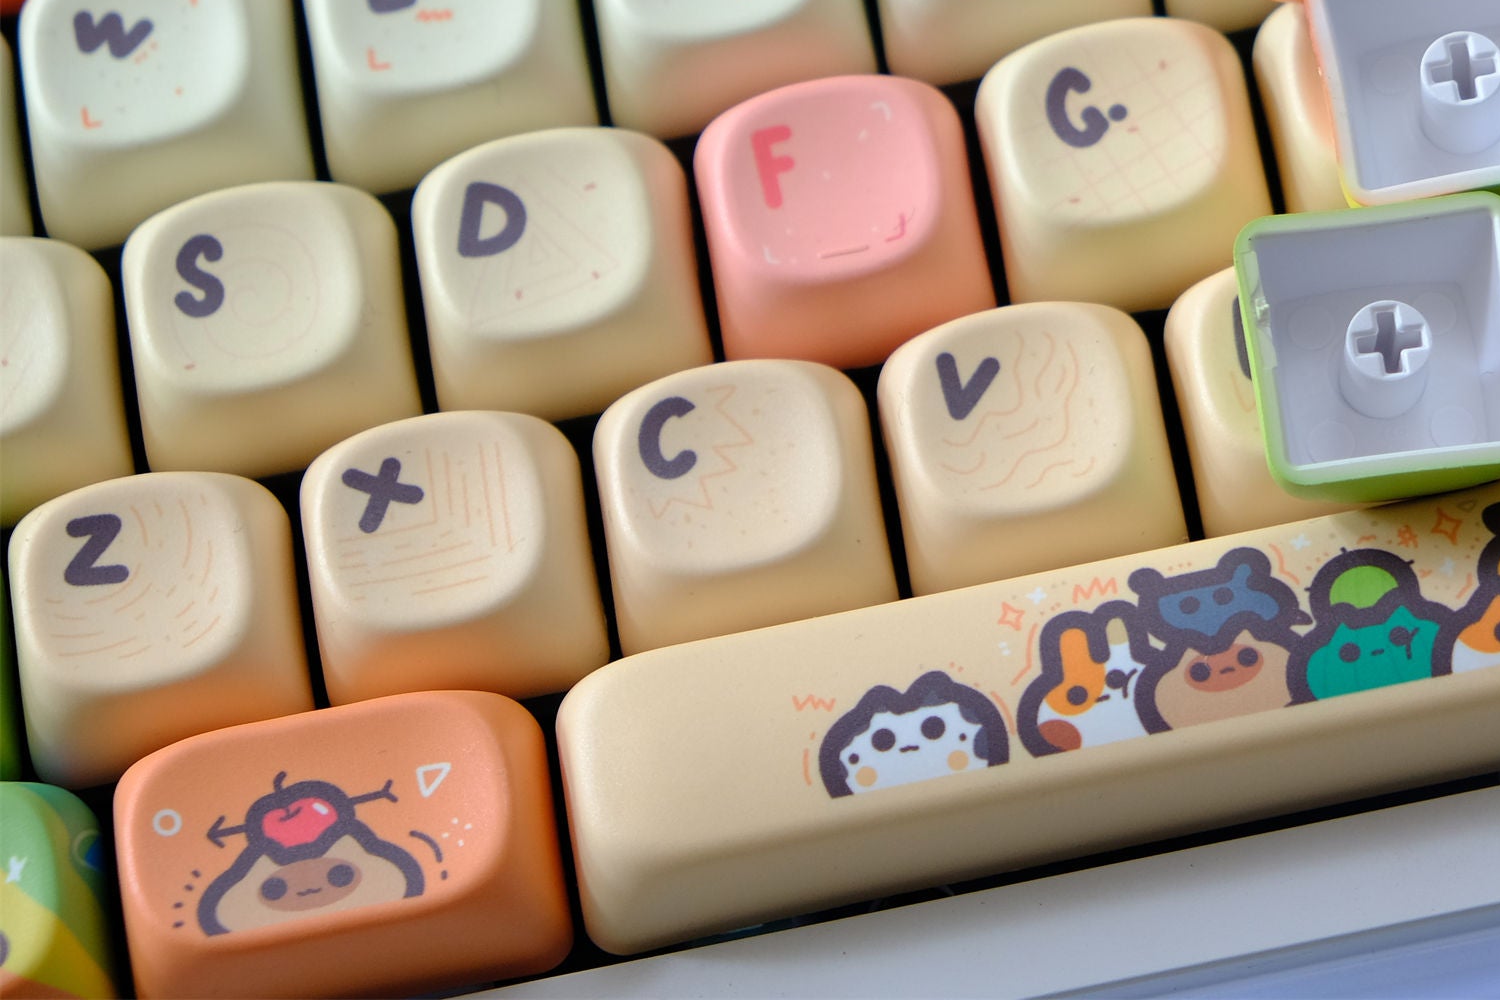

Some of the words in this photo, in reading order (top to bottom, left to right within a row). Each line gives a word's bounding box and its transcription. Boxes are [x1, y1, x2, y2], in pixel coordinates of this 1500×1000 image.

[73, 9, 154, 60] W
[750, 123, 796, 210] F
[457, 181, 528, 259] D
[174, 233, 227, 319] S
[935, 351, 1001, 422] V
[638, 395, 698, 481] C
[341, 456, 426, 534] X
[63, 513, 130, 587] Z
